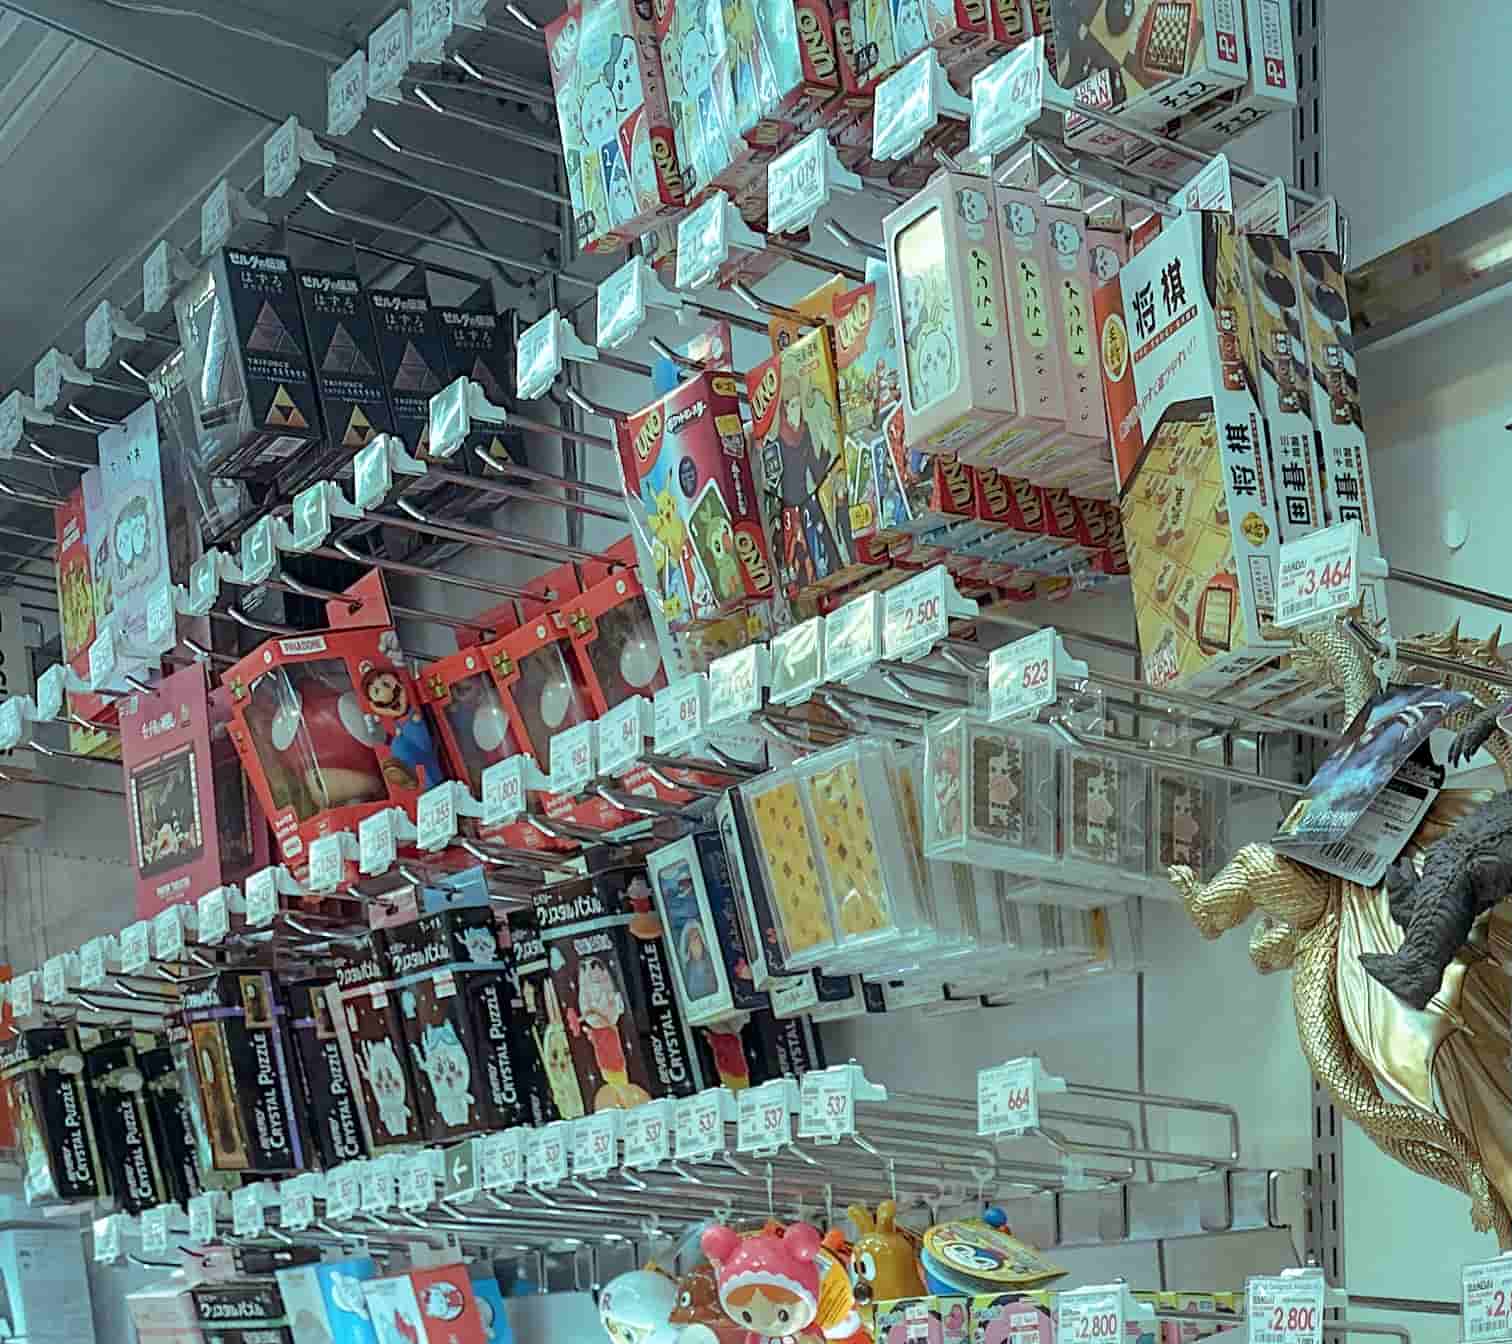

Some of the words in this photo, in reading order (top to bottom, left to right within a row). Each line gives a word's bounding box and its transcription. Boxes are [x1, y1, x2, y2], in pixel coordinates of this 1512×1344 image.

[971, 250, 993, 328] トランプ
[1017, 261, 1042, 338] トランプ
[1063, 280, 1085, 356] トランプ
[1132, 256, 1187, 340] 将棋
[1226, 422, 1257, 497] 将棋
[1023, 659, 1050, 688] 523
